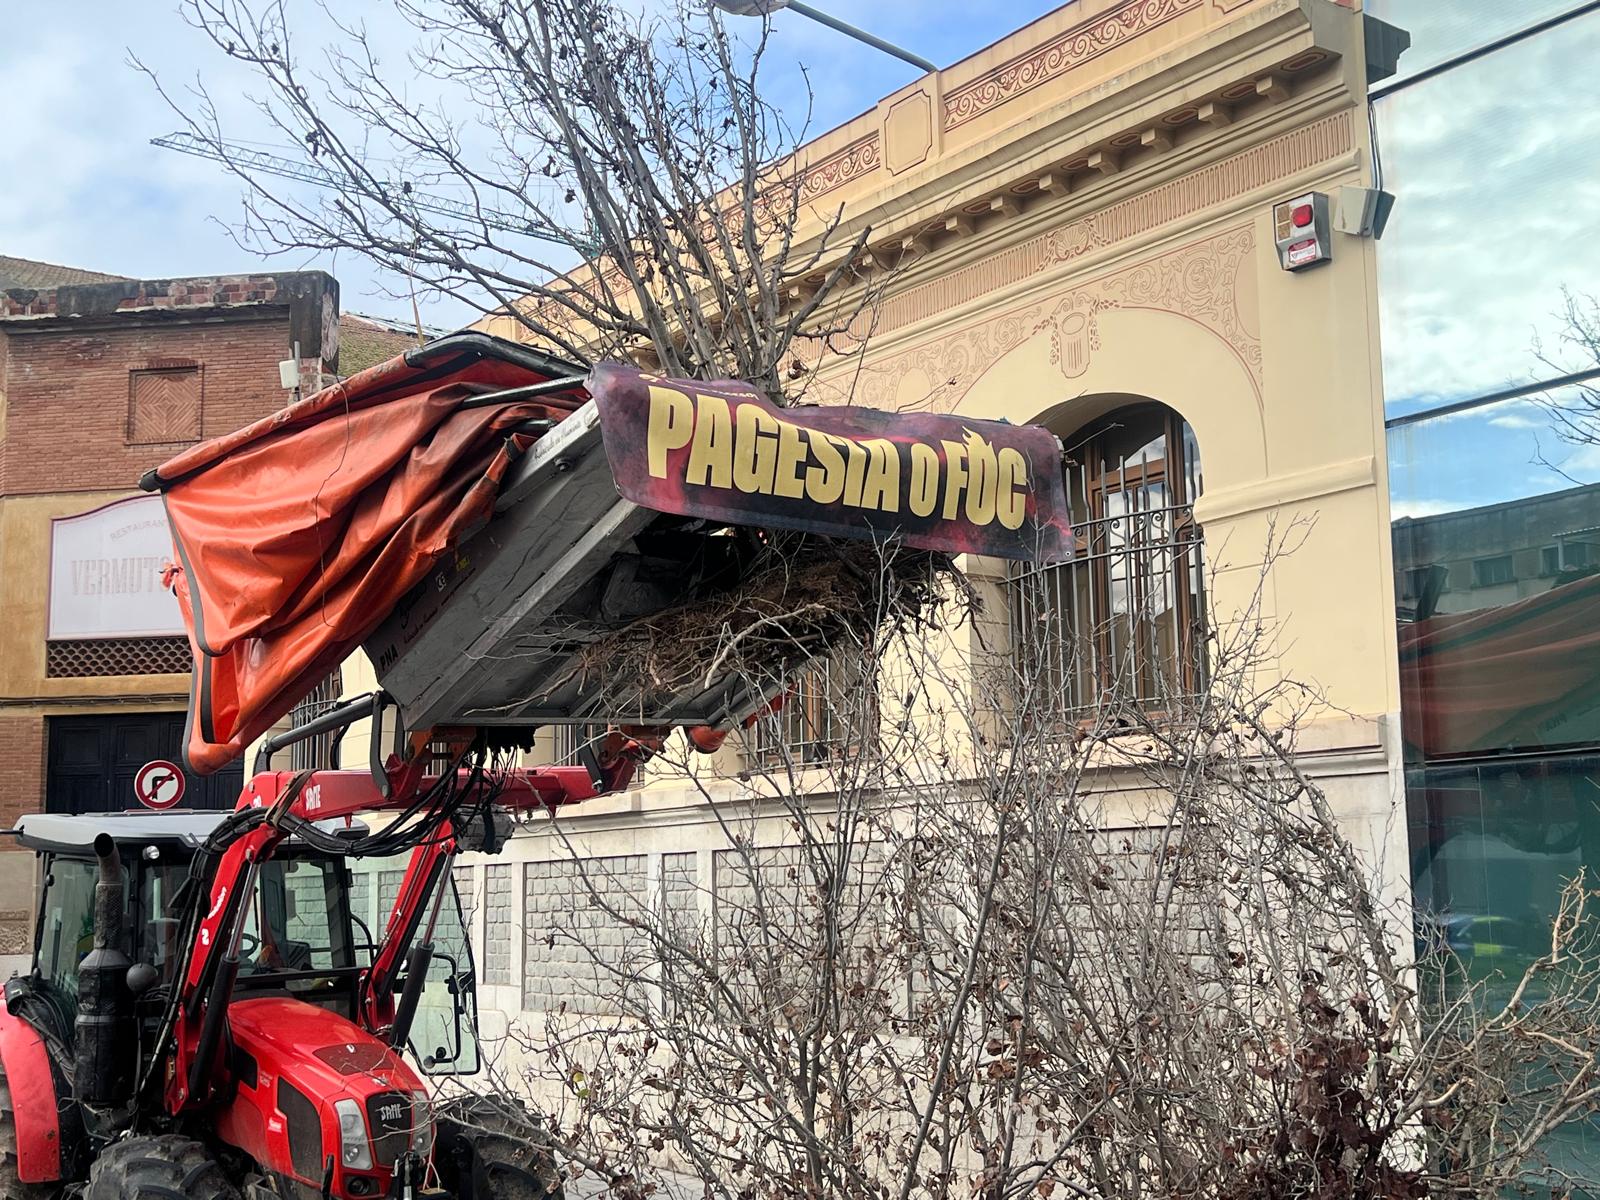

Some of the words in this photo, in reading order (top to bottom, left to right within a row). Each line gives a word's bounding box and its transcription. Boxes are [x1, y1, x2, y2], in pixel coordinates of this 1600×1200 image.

[647, 385, 899, 513] PAGESIA
[909, 442, 940, 517] O
[940, 425, 1027, 531] FOC
[380, 1103, 403, 1121] SAME
